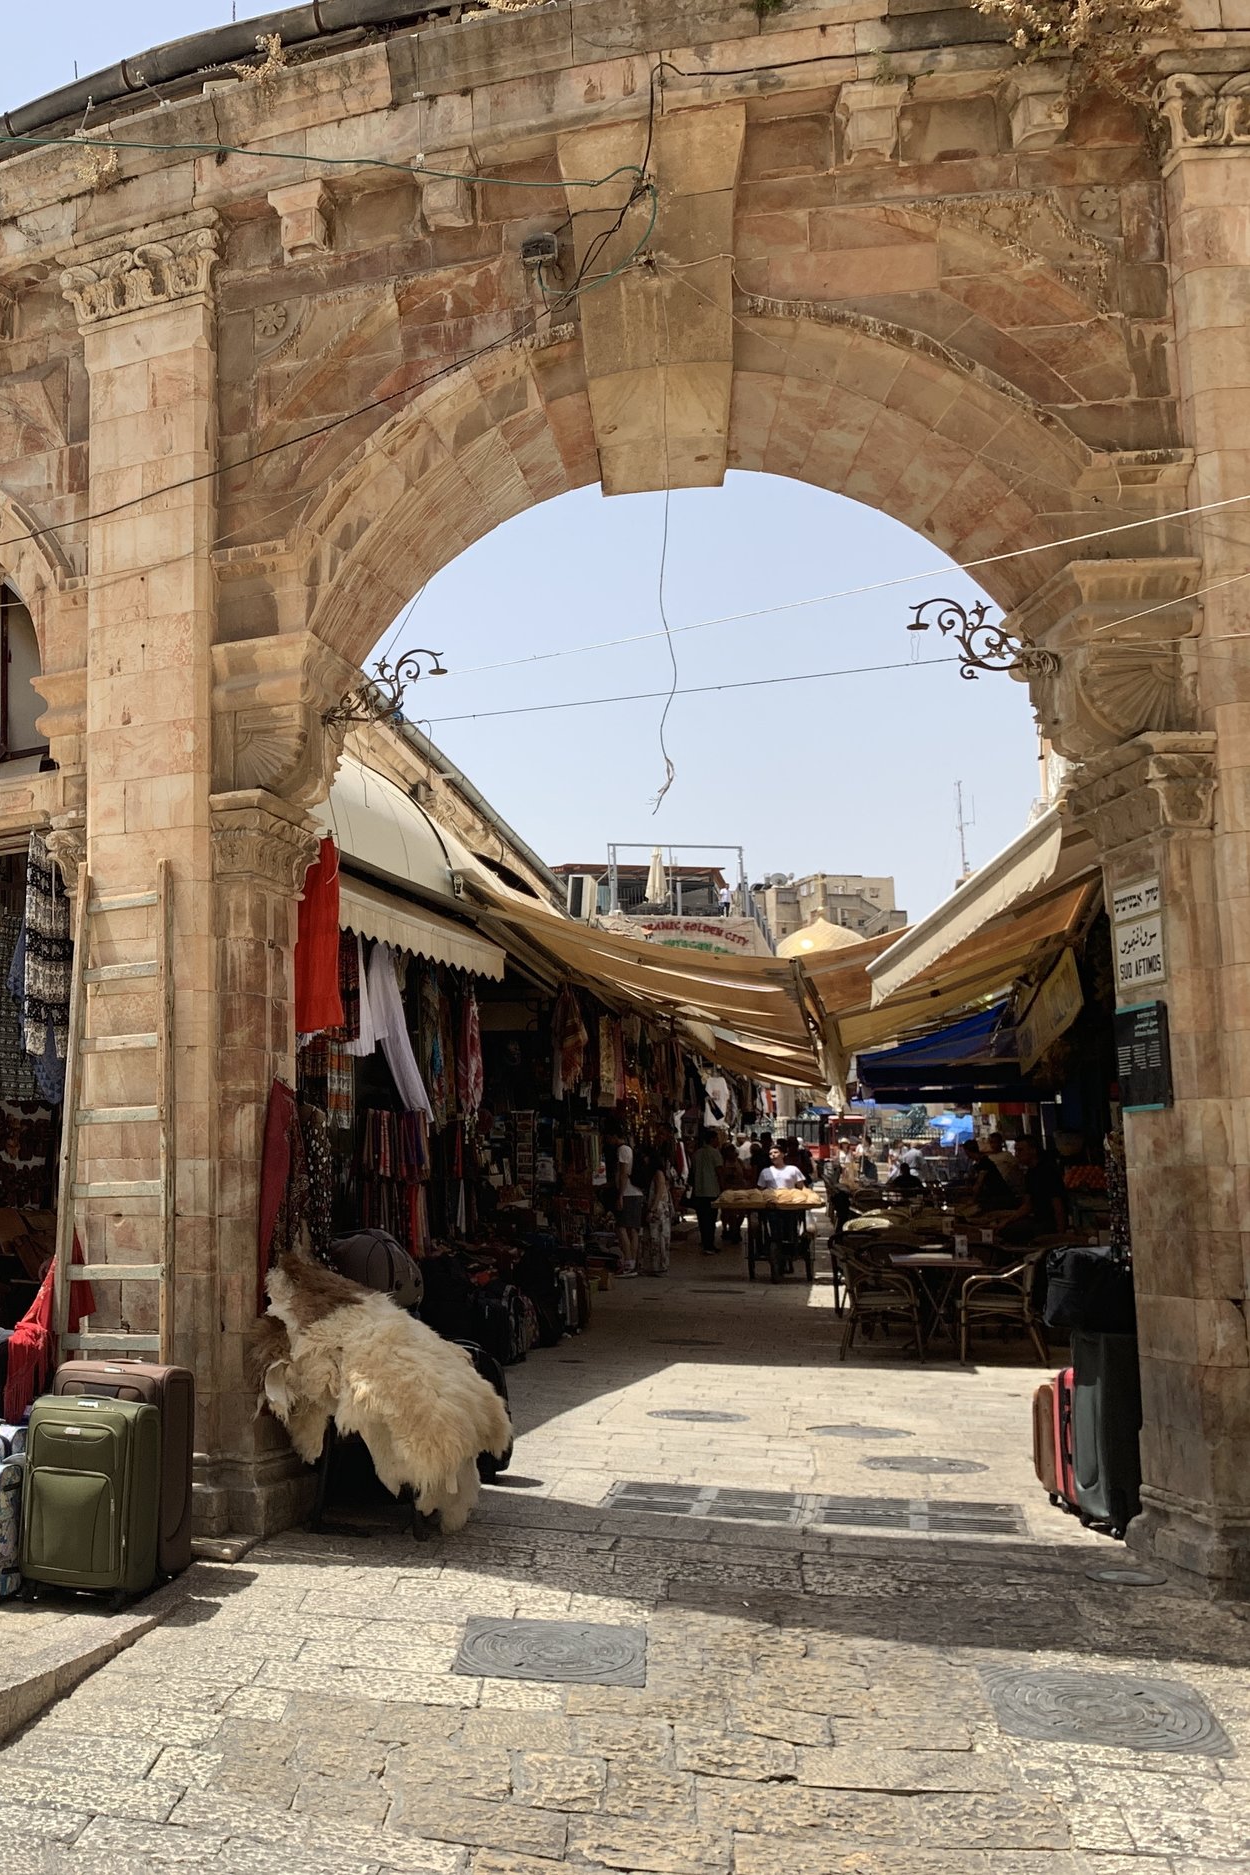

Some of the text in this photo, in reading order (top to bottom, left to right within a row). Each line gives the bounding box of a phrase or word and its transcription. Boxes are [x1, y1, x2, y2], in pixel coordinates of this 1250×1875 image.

[683, 921, 724, 937] GOLDEN
[725, 931, 749, 946] CITY
[1135, 954, 1162, 976] AFTIMOS
